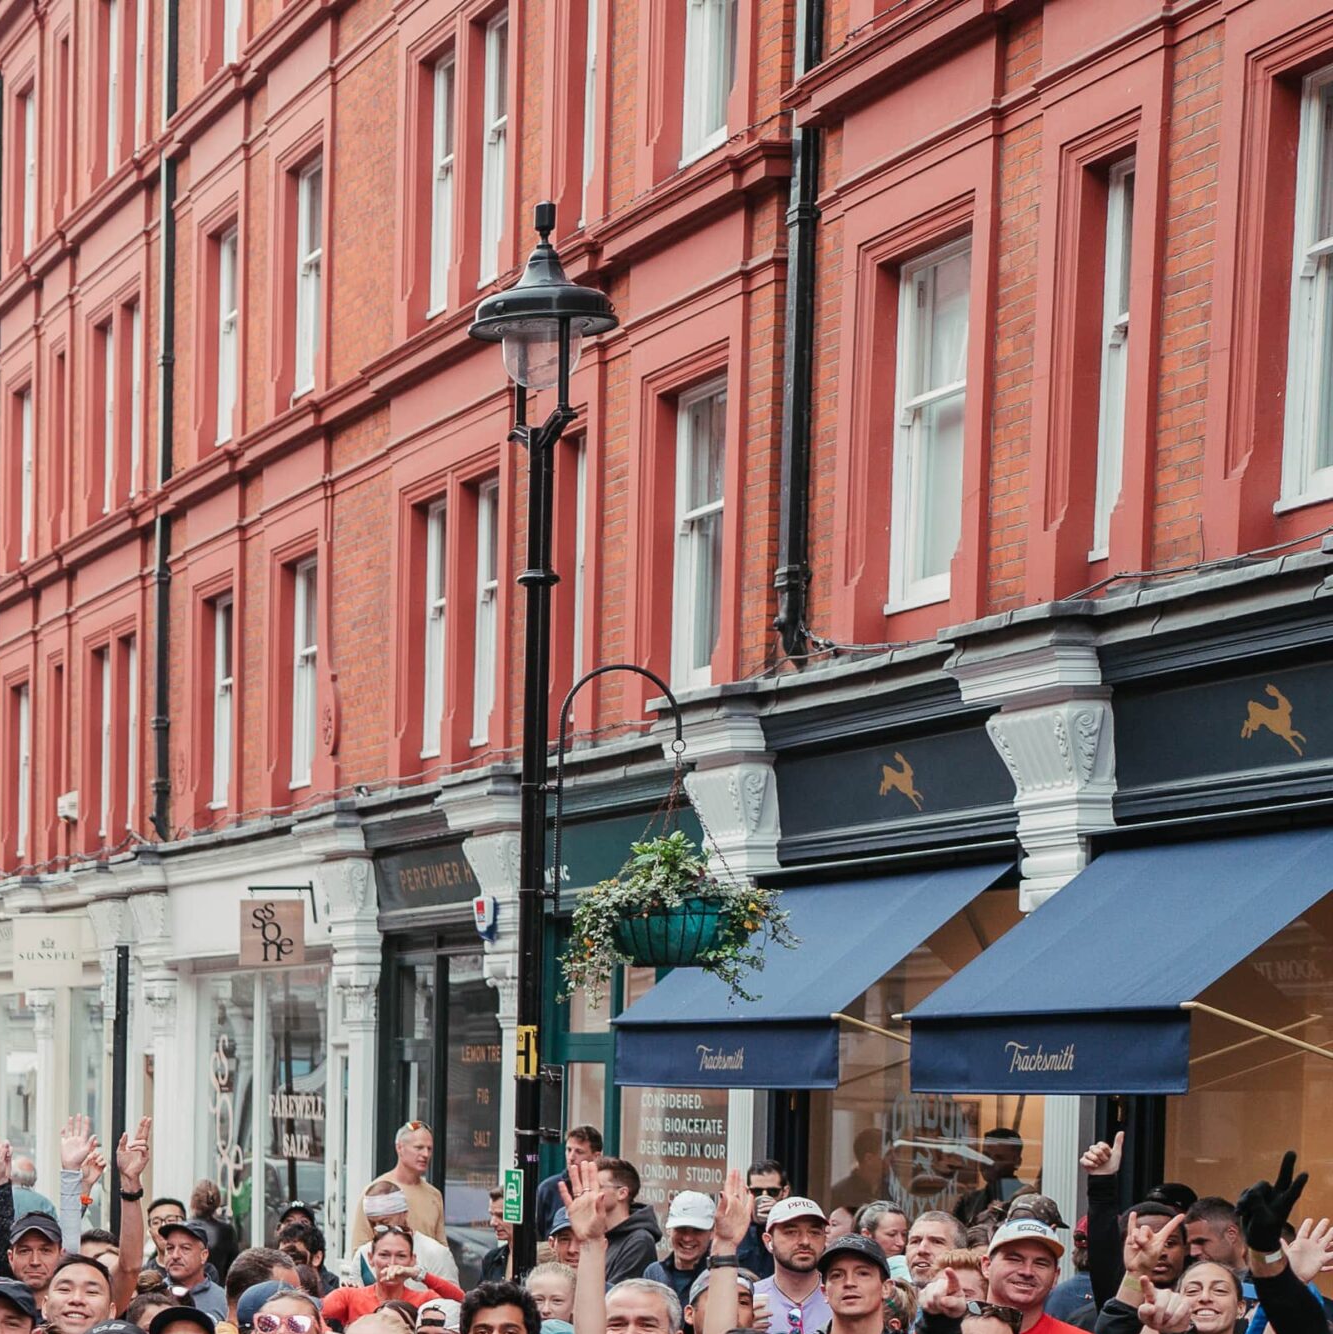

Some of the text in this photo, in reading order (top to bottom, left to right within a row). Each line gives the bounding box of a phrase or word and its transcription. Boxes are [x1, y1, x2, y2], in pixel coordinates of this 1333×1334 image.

[399, 861, 461, 892] PERFUMER
[18, 951, 77, 961] SUNSPEL
[461, 1045, 501, 1062] LEMON TRE
[696, 1044, 744, 1071] Tracksmith
[1005, 1040, 1075, 1073] Tracksmith
[476, 1088, 489, 1104] FIG
[641, 1093, 704, 1109] CONSIDERED.
[268, 1094, 325, 1121] FAREWELL
[664, 1118, 726, 1135] BIOACETATE.
[282, 1132, 311, 1159] SALE
[473, 1131, 491, 1147] SALT
[640, 1140, 726, 1160] DESIGNED IN OUR
[640, 1165, 724, 1184] LONDON STUDIO.
[787, 1200, 813, 1210] PPTC
